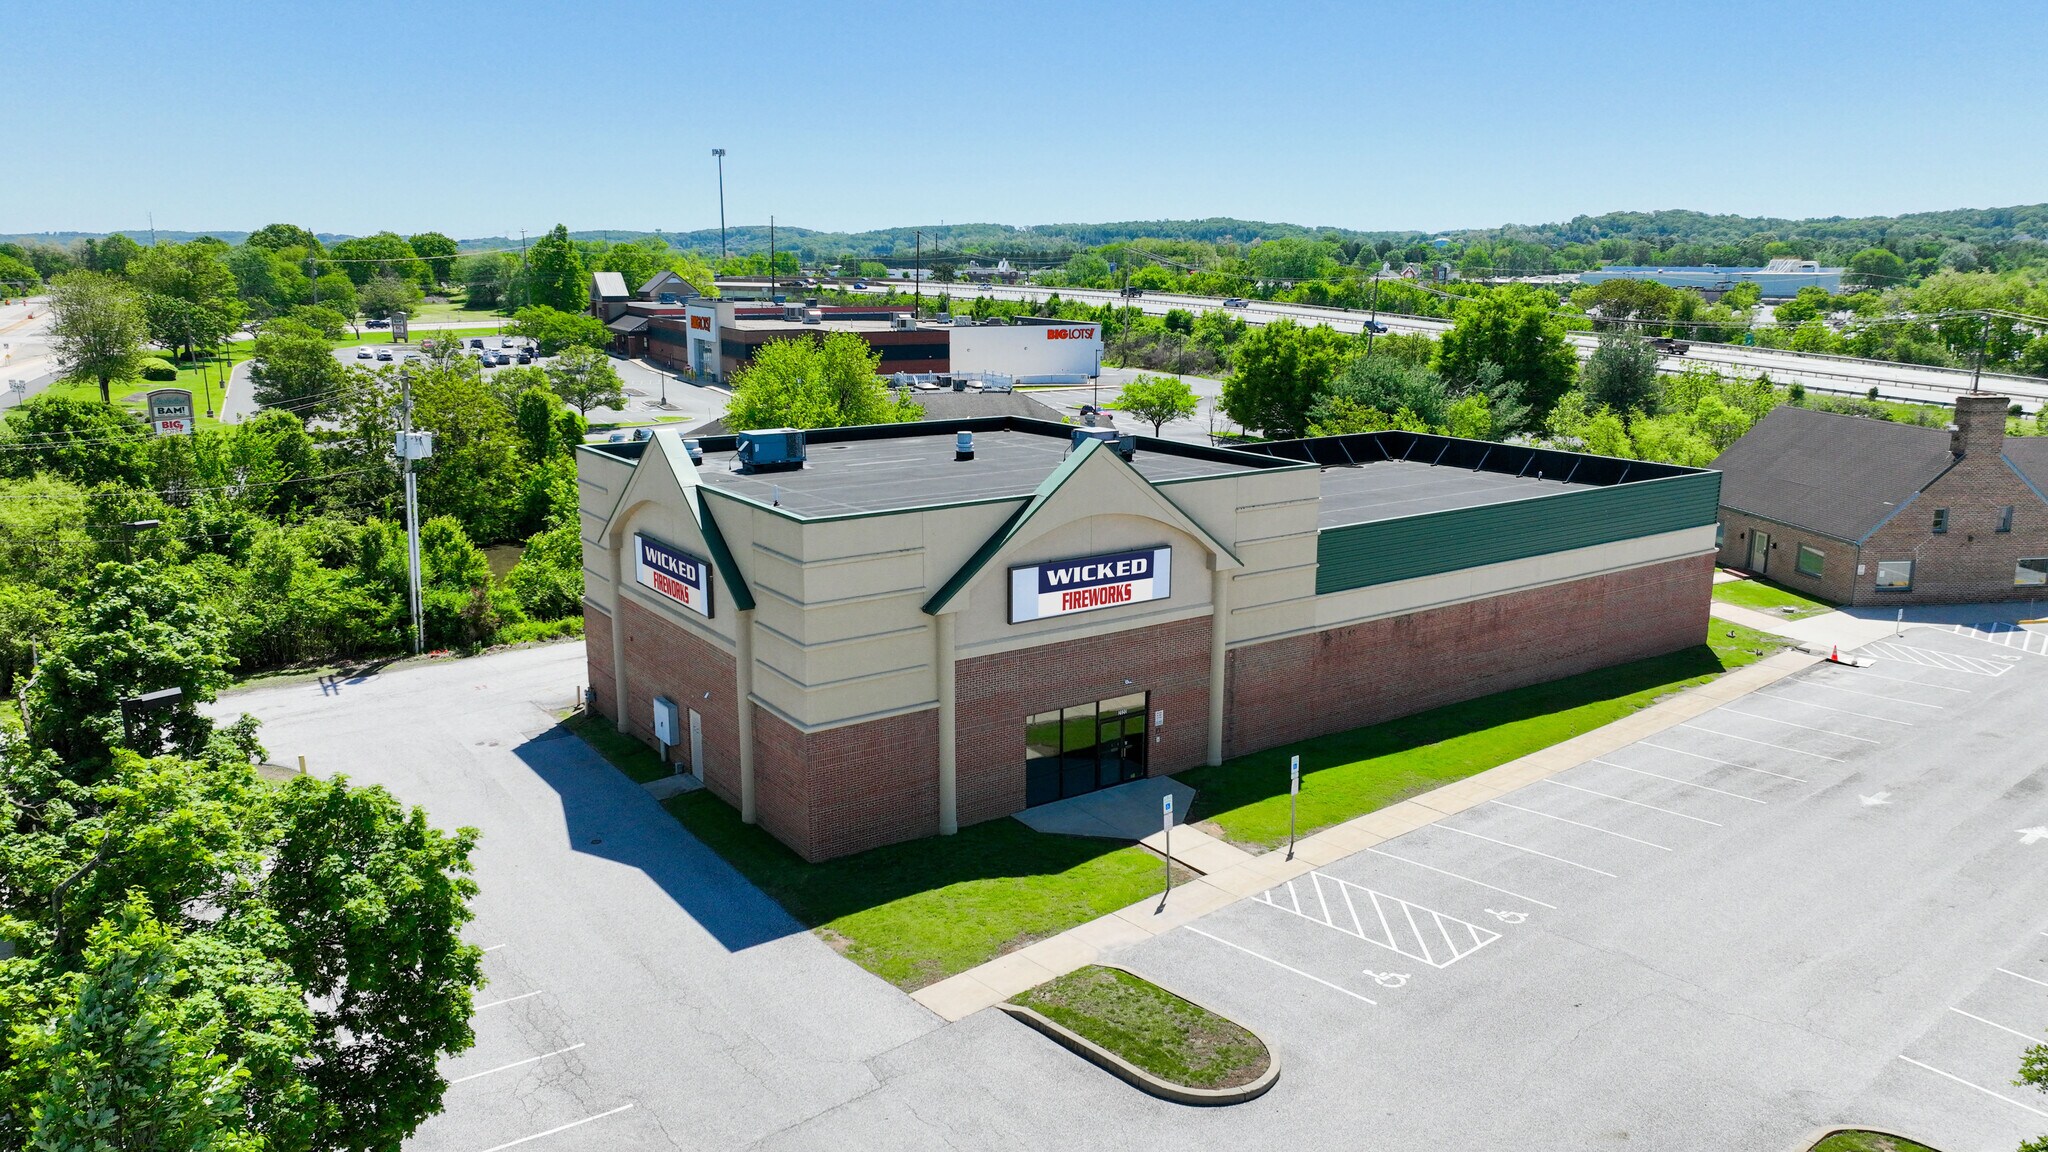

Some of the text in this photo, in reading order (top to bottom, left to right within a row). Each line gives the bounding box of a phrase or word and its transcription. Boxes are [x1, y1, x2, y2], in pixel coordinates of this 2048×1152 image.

[1047, 328, 1095, 340] BIG LOTS!
[157, 406, 185, 415] BAM!
[162, 420, 181, 429] BIG
[645, 545, 696, 582] WICKED
[1047, 558, 1148, 586] WICKED
[653, 571, 690, 604] FIREWORKS
[1062, 583, 1132, 611] FIREWORKS
